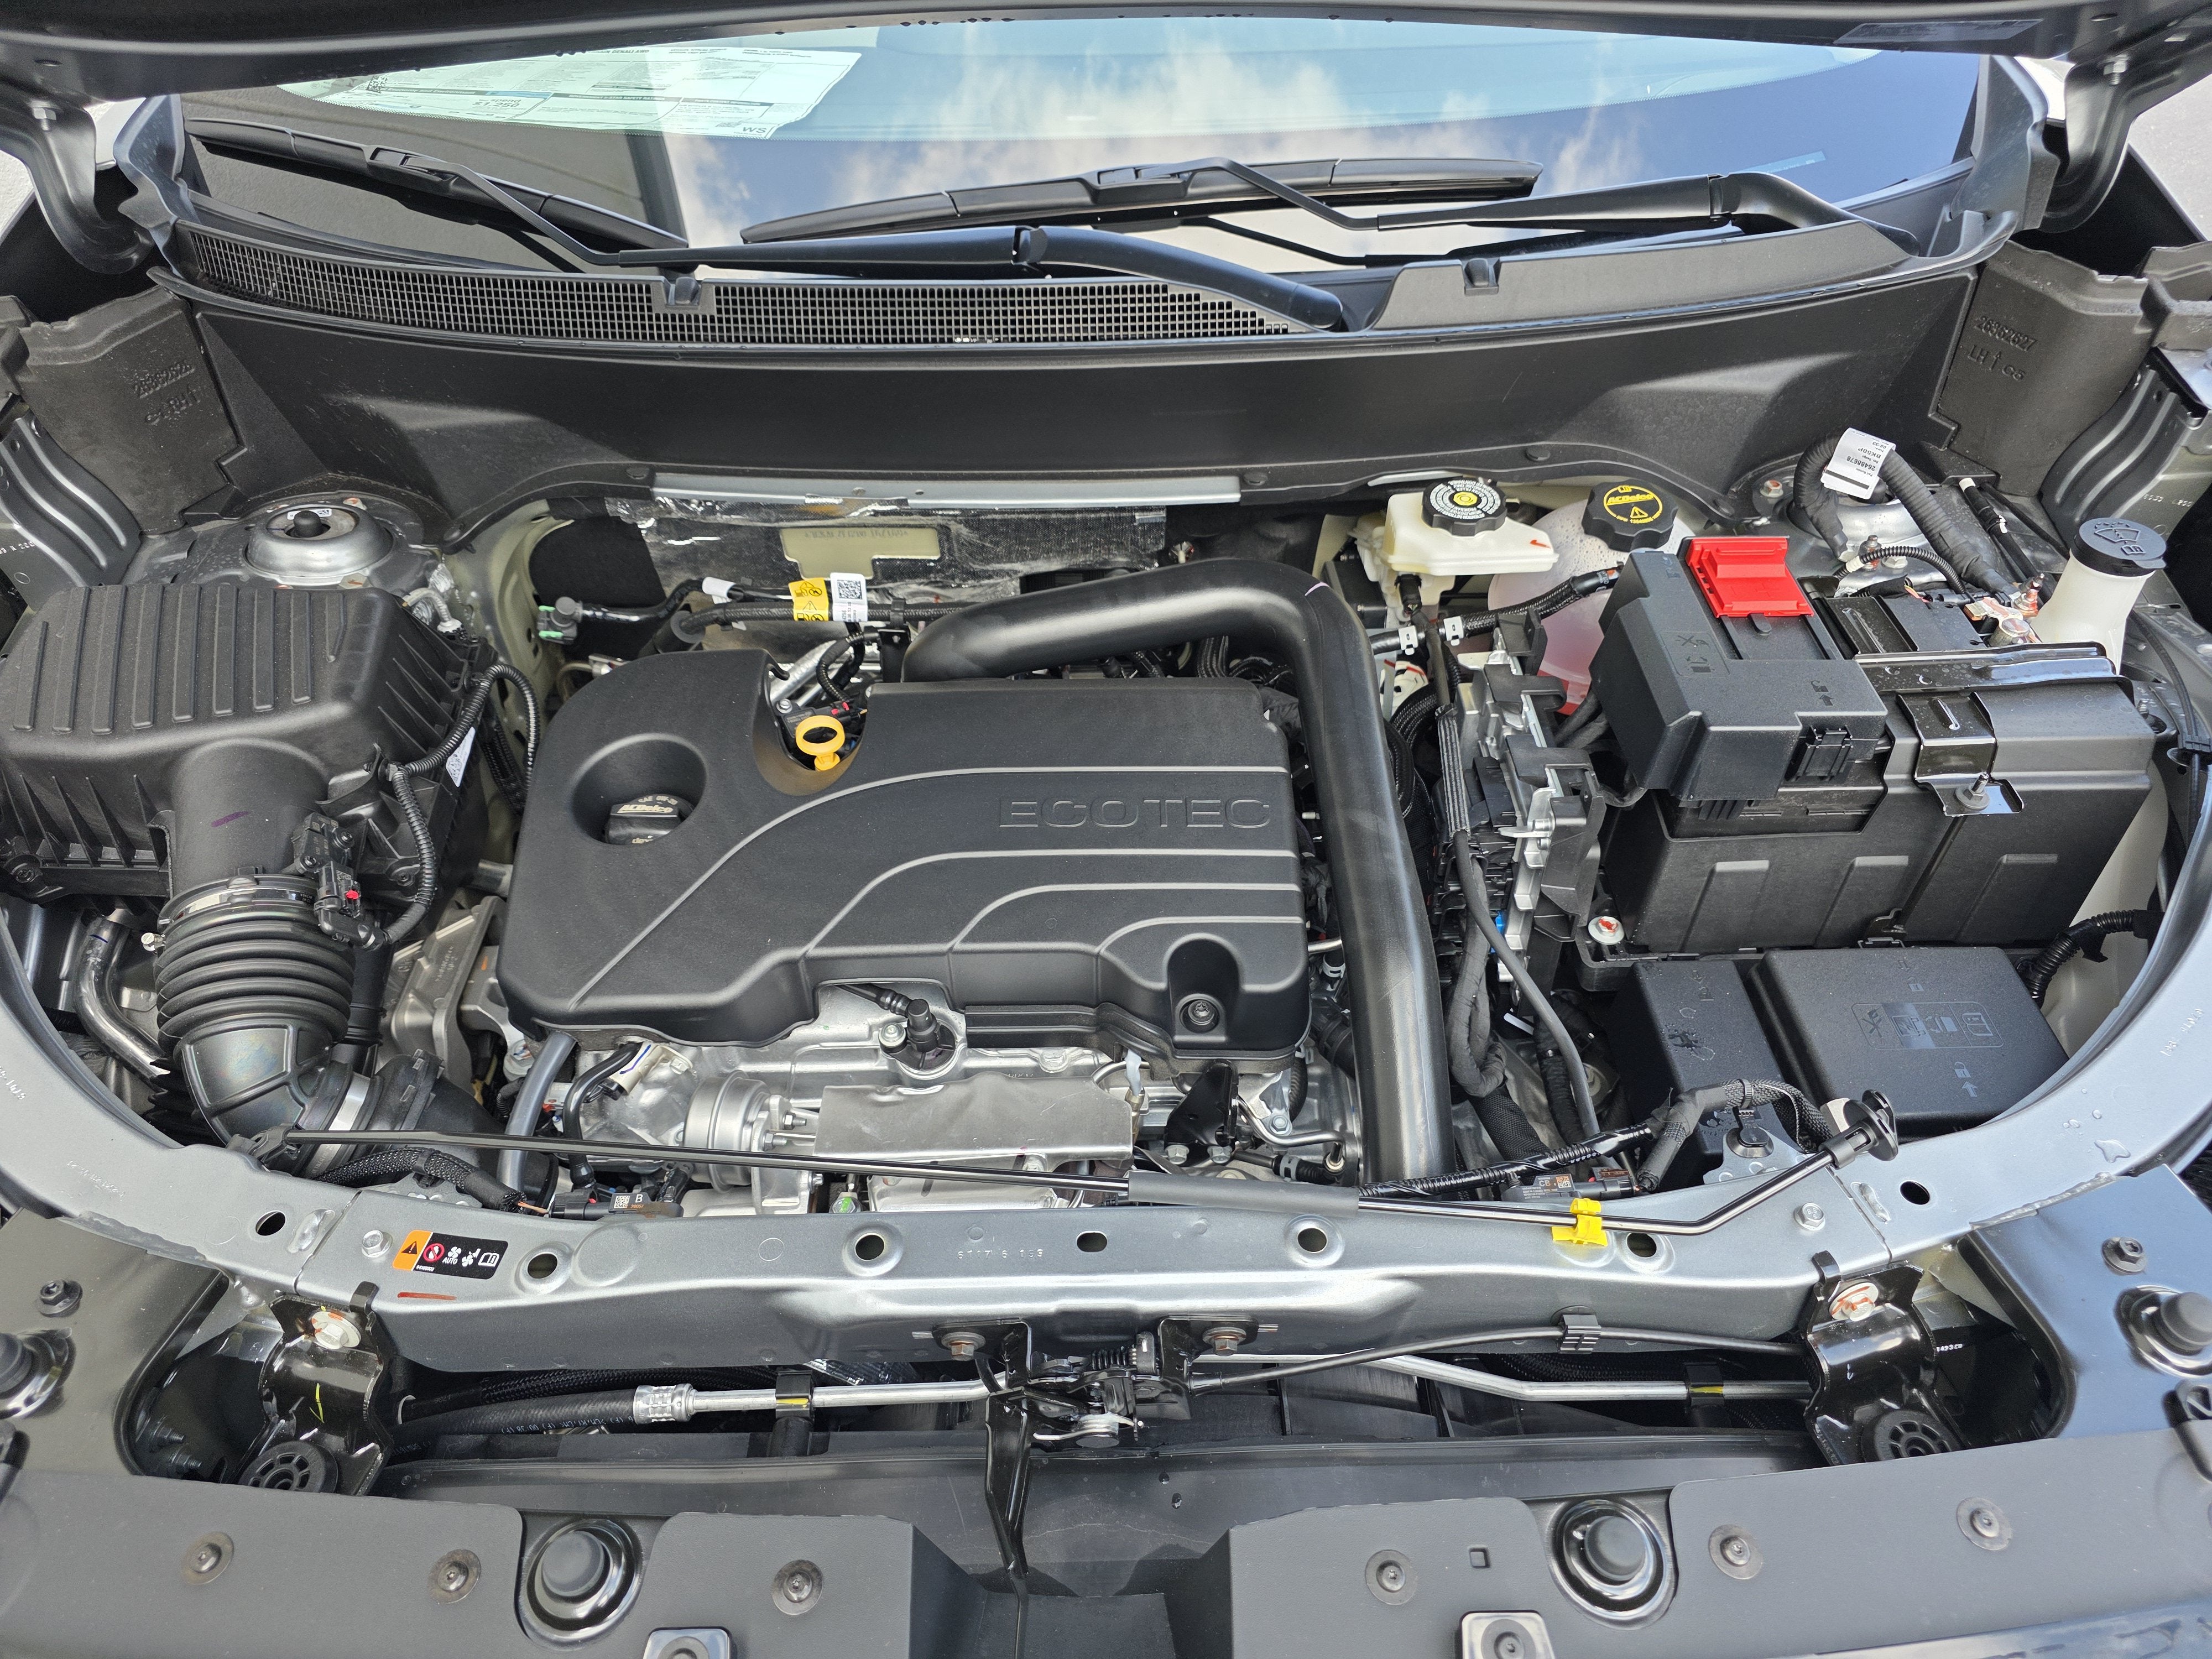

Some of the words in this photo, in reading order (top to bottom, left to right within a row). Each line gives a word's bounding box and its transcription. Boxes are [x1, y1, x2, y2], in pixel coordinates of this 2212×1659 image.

[1967, 345, 1989, 365] LH
[1858, 447, 1882, 460] BK50P
[1846, 456, 1876, 471] 26488678
[1606, 493, 1655, 504] ACDelco
[617, 804, 674, 813] ACDelco
[999, 796, 1270, 828] ECOTEC
[635, 1194, 643, 1203] B
[442, 1256, 458, 1265] AUTO
